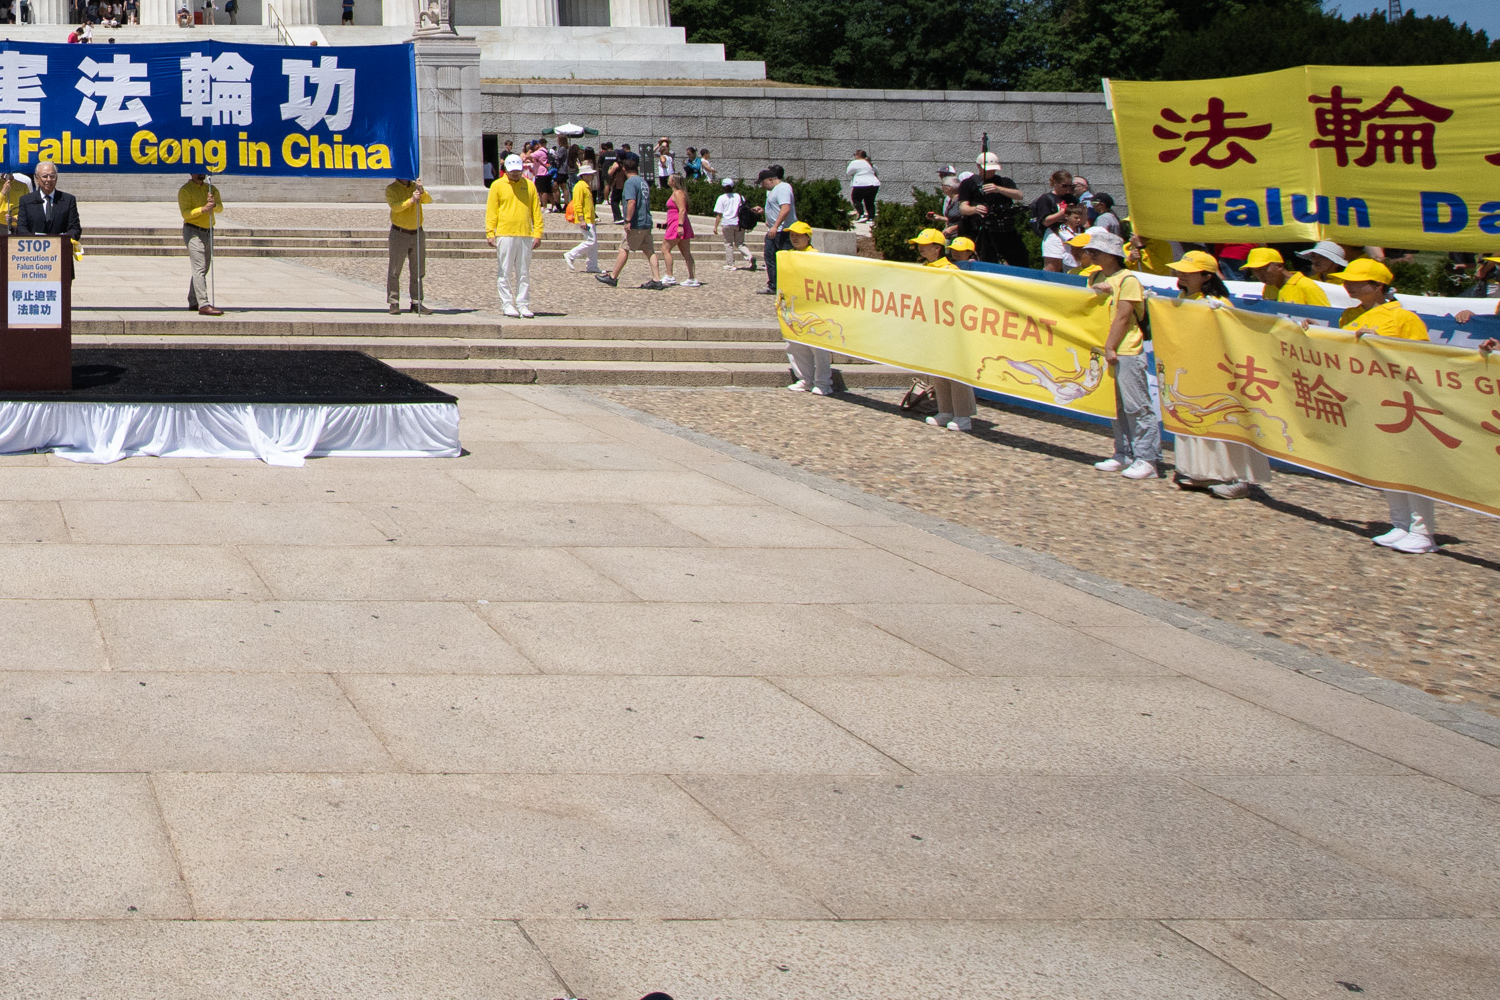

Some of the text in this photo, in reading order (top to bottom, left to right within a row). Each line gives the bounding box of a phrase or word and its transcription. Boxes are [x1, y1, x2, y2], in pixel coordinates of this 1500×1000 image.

[1153, 85, 1500, 170] 法輪
[19, 131, 118, 165] Falun
[130, 131, 227, 173] Gong
[238, 132, 271, 167] in
[281, 133, 392, 170] China
[1192, 187, 1370, 228] Falun
[11, 254, 57, 262] Persecution of
[17, 239, 51, 252] STOP
[35, 263, 52, 271] Gong
[12, 289, 57, 302] 停止迫害
[17, 304, 51, 315] 法輪功
[803, 277, 1058, 347] FALUN DAFA IS GREAT
[1280, 340, 1500, 397] FALUN DAFA IS G
